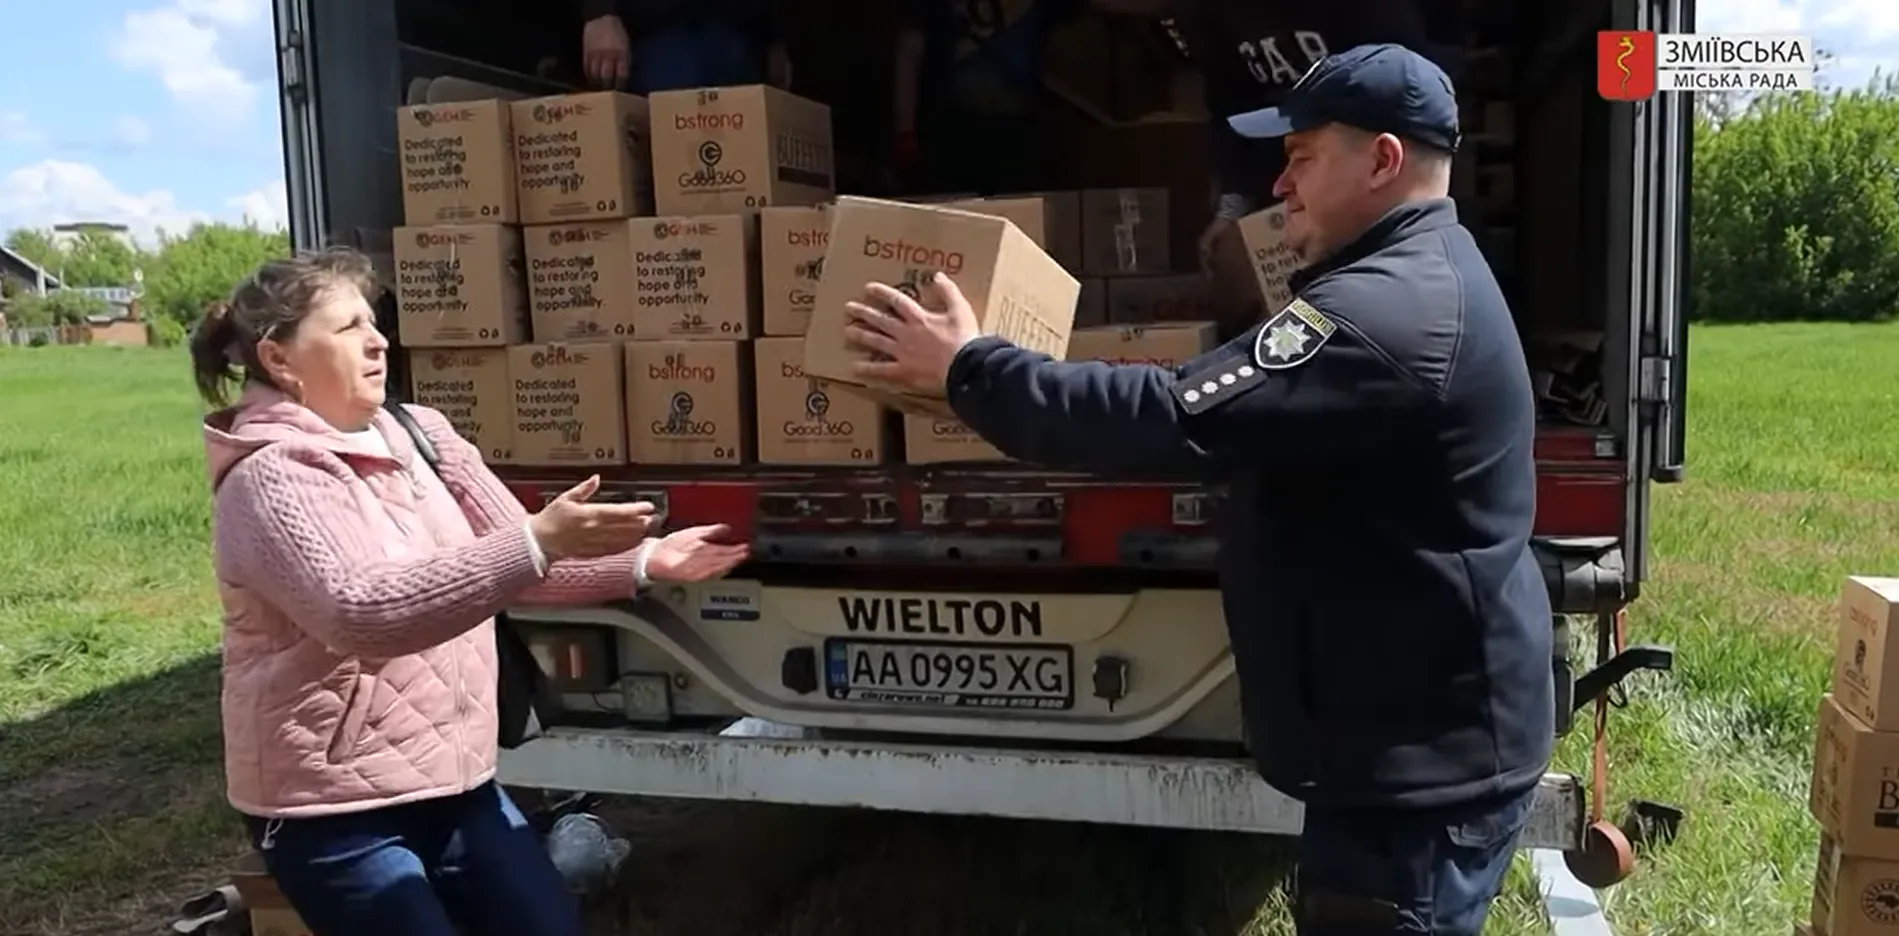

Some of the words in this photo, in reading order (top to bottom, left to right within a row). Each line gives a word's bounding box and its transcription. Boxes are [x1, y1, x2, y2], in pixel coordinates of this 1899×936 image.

[675, 112, 744, 130] bstrong
[518, 130, 577, 147] Dedicated
[519, 150, 531, 160] to
[532, 146, 582, 160] restoring
[407, 167, 436, 178] hope
[520, 163, 550, 176] hope
[552, 160, 576, 172] and
[863, 234, 964, 275] bstrong
[637, 266, 650, 277] to
[533, 273, 546, 284] to
[535, 286, 566, 298] hope
[638, 280, 671, 292] hope
[402, 287, 432, 299] hope
[649, 363, 715, 383] bstrong
[417, 380, 474, 392] Dedicated
[515, 378, 576, 390] Dedicated
[515, 393, 528, 403] to
[529, 392, 580, 405] restoring
[517, 407, 547, 418] hope
[550, 406, 574, 417] and
[783, 420, 854, 437] Good360
[838, 596, 1043, 637] WIELTON
[852, 651, 903, 686] AA
[910, 652, 998, 691] 0995
[1005, 654, 1064, 693] XG
